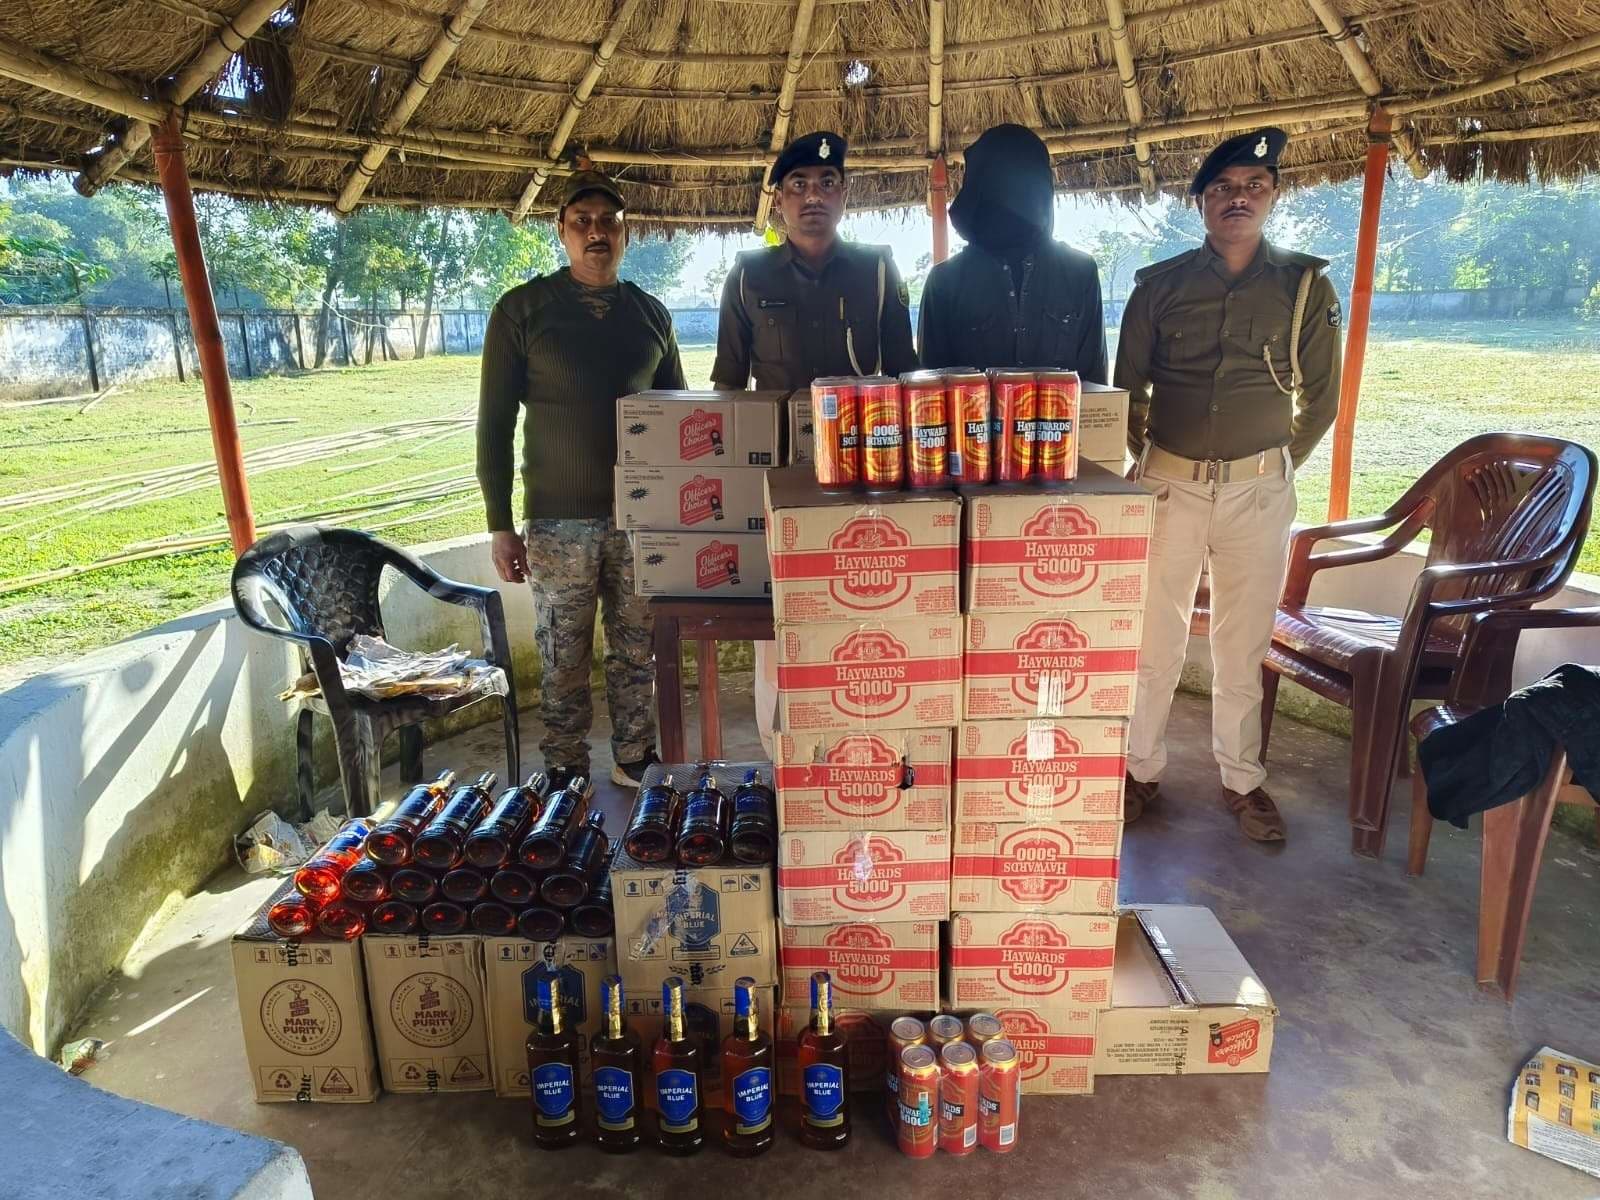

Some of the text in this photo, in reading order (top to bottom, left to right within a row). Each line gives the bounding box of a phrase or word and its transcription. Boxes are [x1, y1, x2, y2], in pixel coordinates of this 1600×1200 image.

[873, 424, 900, 437] 5000
[1024, 431, 1035, 442] 50
[919, 437, 945, 448] 5000
[976, 433, 989, 444] 50
[1024, 542, 1095, 558] HAYWARDS
[834, 554, 907, 570] HAYWARDS
[1036, 558, 1082, 574] 5000
[847, 570, 893, 587] 5000
[1017, 654, 1085, 669] HAYWARDS
[835, 666, 905, 681] HAYWARDS
[1028, 669, 1073, 684] 5000
[848, 680, 893, 697] 5000
[1011, 760, 1077, 774] HAYWARDS
[828, 768, 896, 782] HAYWARDS
[1022, 774, 1065, 788] 5000
[840, 782, 884, 798] 5000
[1016, 847, 1057, 861] 5000
[1003, 861, 1067, 875] HAYWARDS
[849, 879, 889, 894] 5000
[828, 950, 891, 965] HAYWARDS
[1001, 949, 1065, 964] HAYWARDS
[839, 964, 880, 978] 5000
[1012, 962, 1053, 977] 5000
[415, 1010, 449, 1019] MARK
[284, 1018, 319, 1026] MARK
[412, 1017, 455, 1027] PURITY
[283, 1026, 325, 1035] PURITY
[536, 1079, 571, 1090] IMPERIAL
[596, 1084, 629, 1093] IMPERIAL
[659, 1086, 692, 1095] IMPERIAL
[737, 1083, 769, 1098] IMPERIAL
[543, 1088, 562, 1096] BLUE
[745, 1093, 763, 1102] BLUE
[813, 1088, 832, 1096] BLUE
